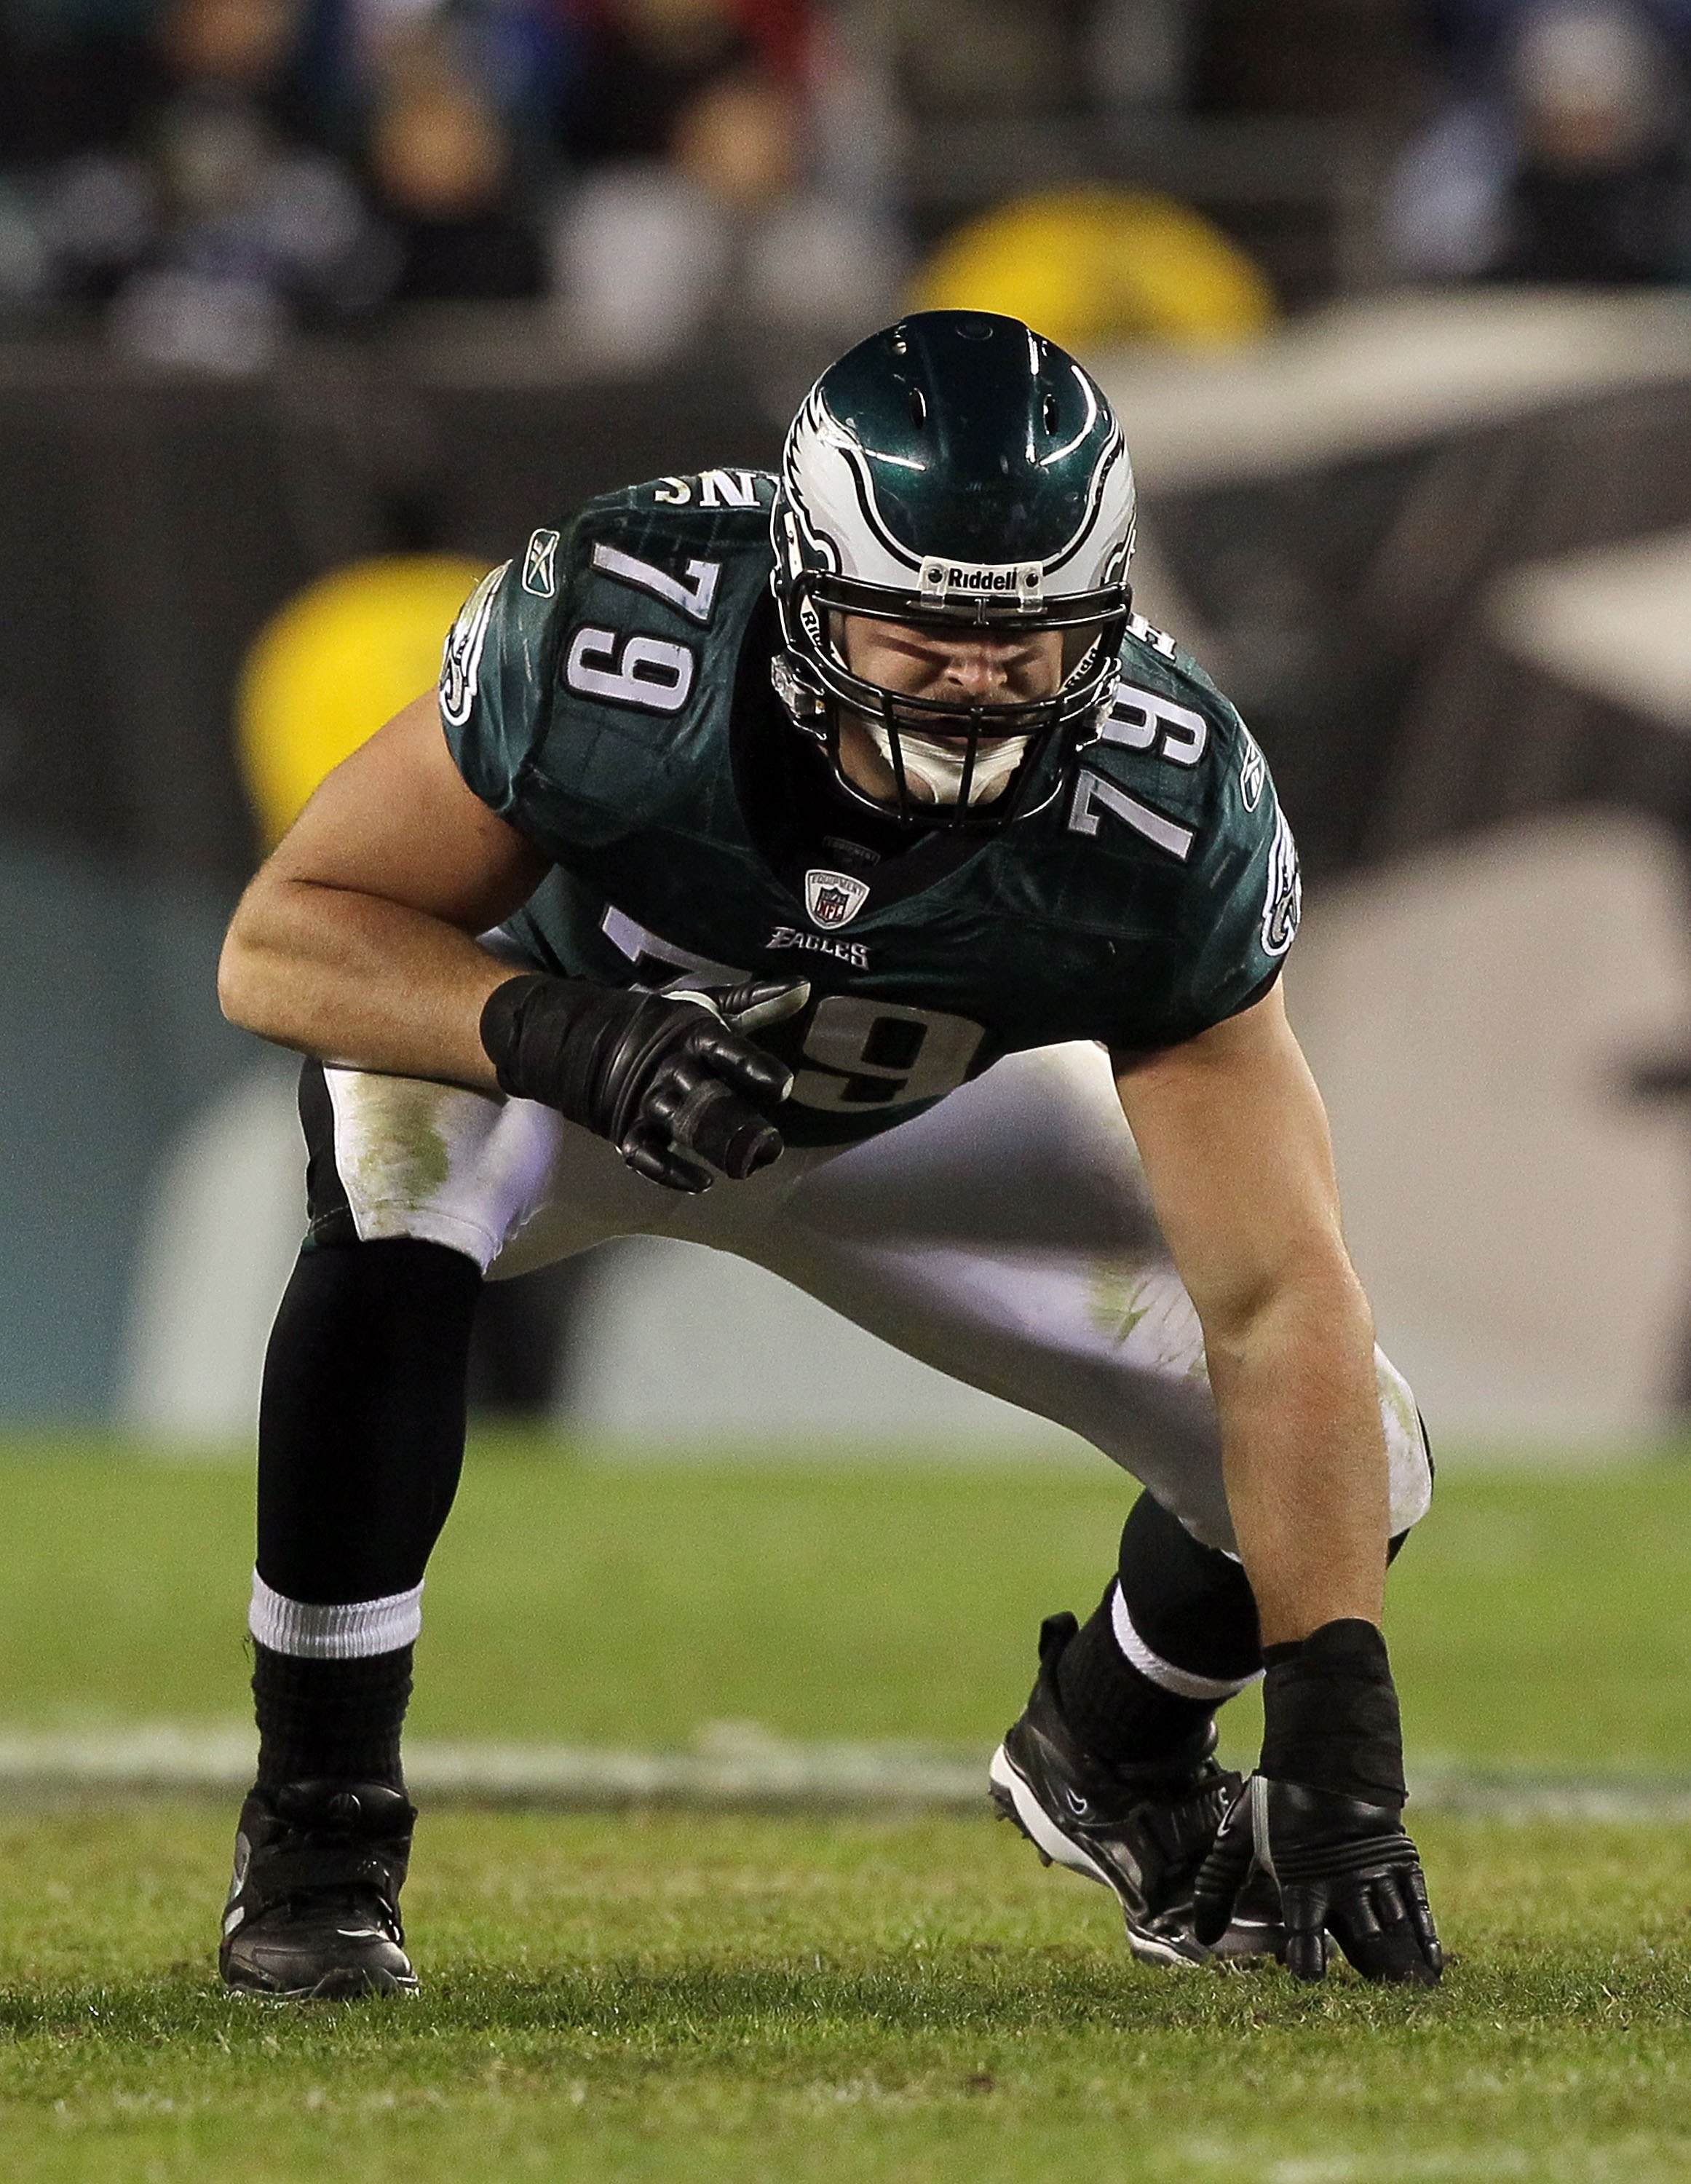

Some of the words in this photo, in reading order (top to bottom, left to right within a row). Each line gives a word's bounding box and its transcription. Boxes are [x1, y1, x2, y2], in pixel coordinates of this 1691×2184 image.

[949, 566, 1018, 591] Riddell
[567, 542, 721, 712] 79
[1068, 681, 1208, 861] 79
[817, 901, 844, 921] NFL
[766, 926, 873, 970] EAGLES
